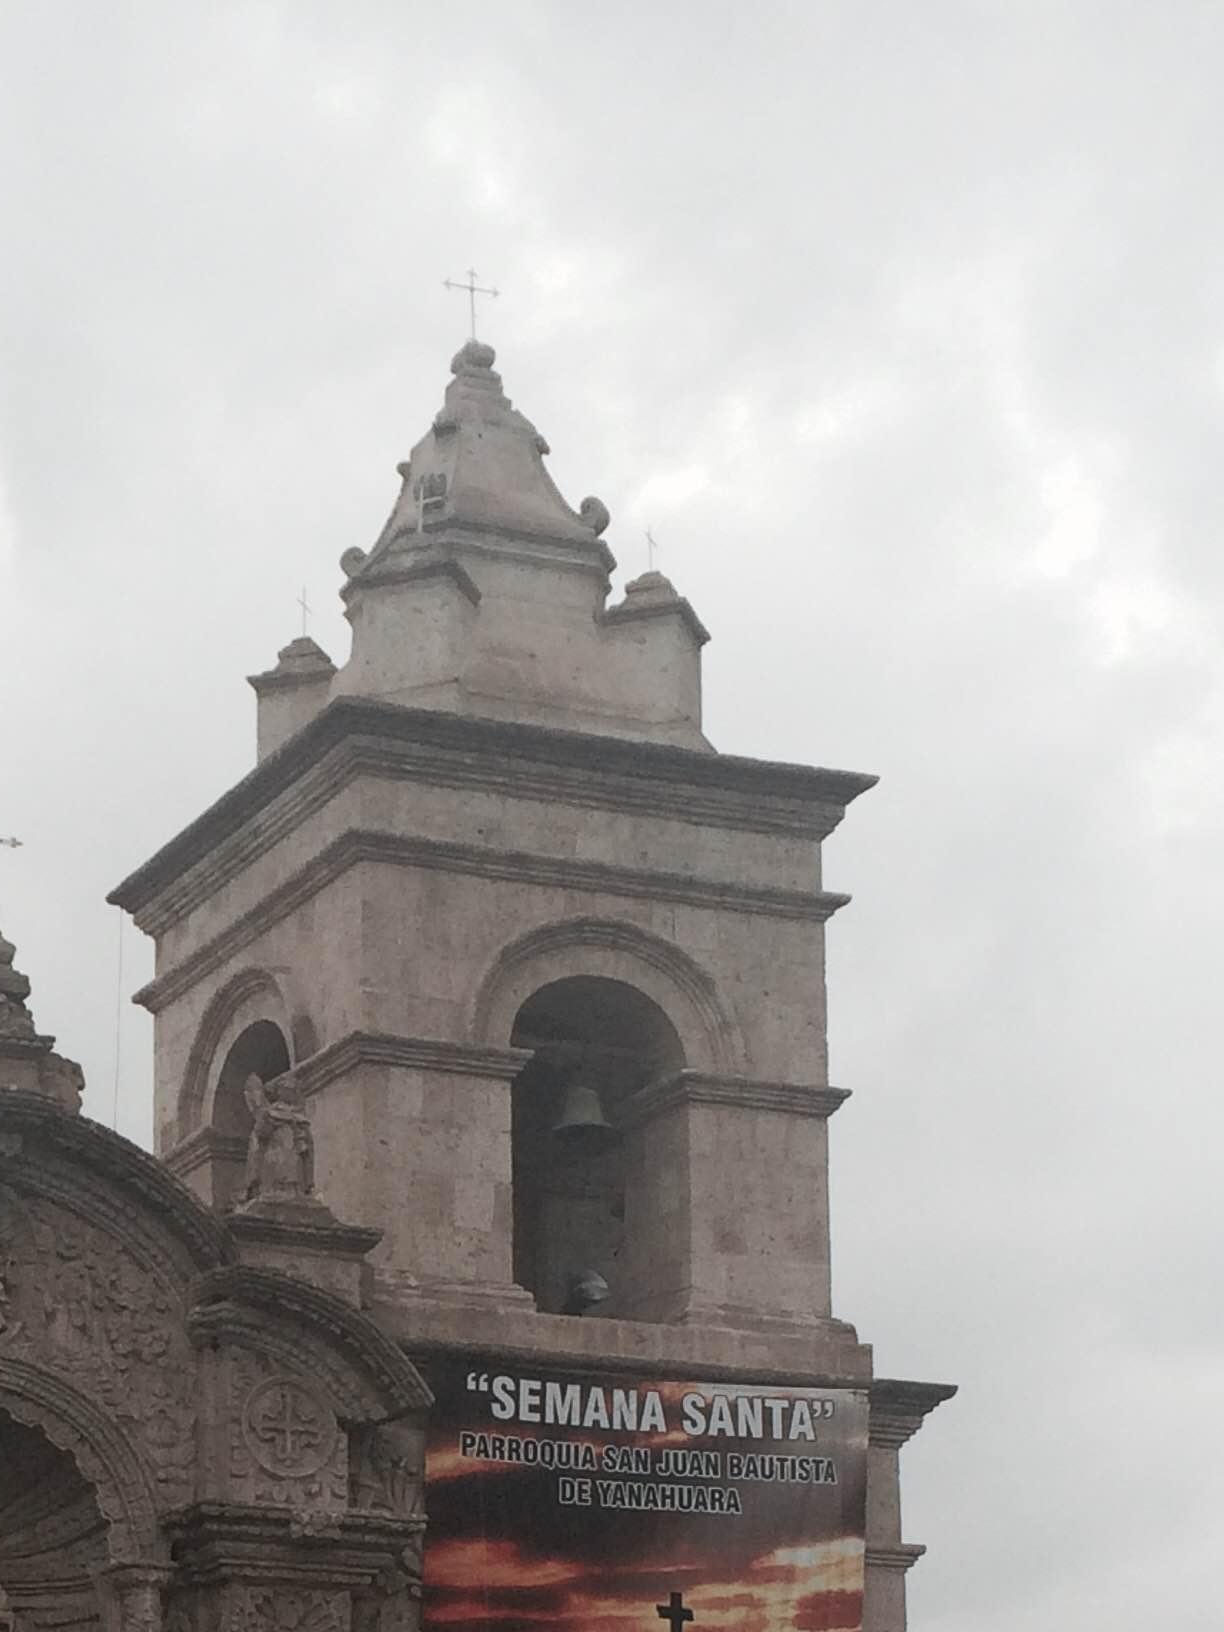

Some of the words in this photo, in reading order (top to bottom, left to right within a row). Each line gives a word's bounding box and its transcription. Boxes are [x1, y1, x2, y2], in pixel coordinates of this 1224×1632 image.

[459, 1431, 596, 1472] PARROQUIA
[603, 1445, 650, 1474] SAN
[656, 1449, 720, 1478] JUAN
[727, 1453, 837, 1484] BAUTISTA
[558, 1477, 592, 1505] DE
[596, 1480, 741, 1515] YANAHUARA
